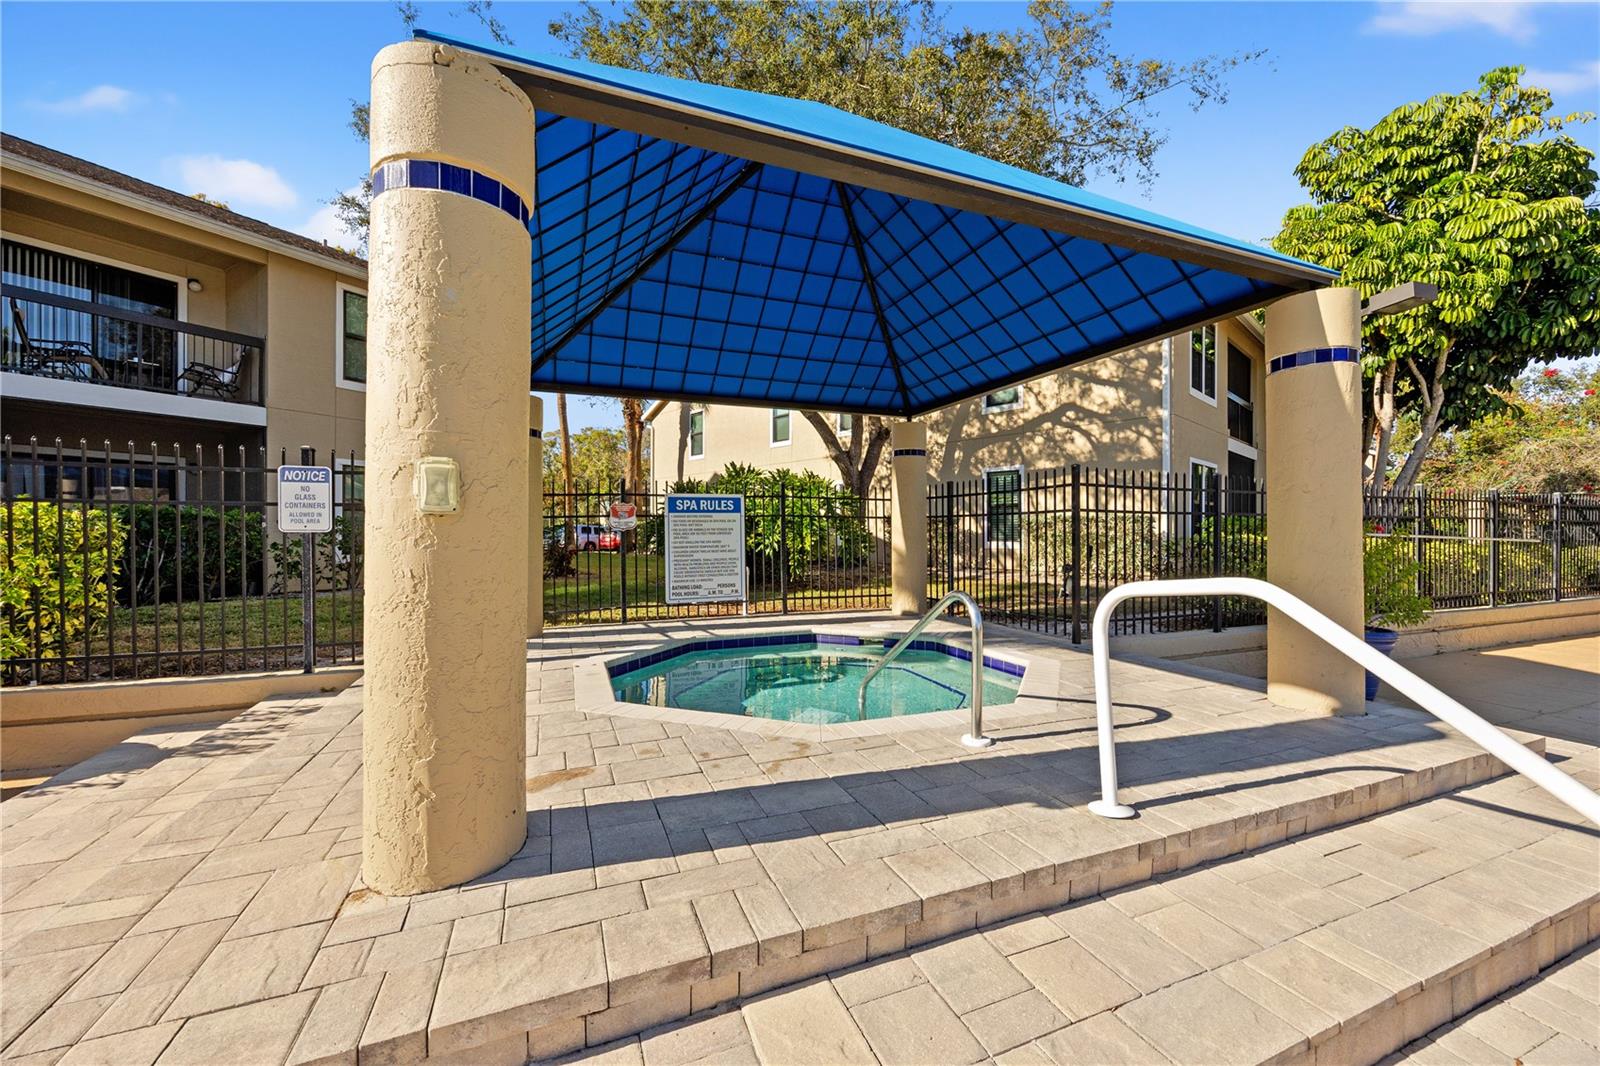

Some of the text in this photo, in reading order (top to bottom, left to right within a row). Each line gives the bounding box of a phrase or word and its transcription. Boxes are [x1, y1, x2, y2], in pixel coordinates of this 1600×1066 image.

[284, 470, 326, 481] NOTICE
[676, 499, 734, 510] SPA RULES
